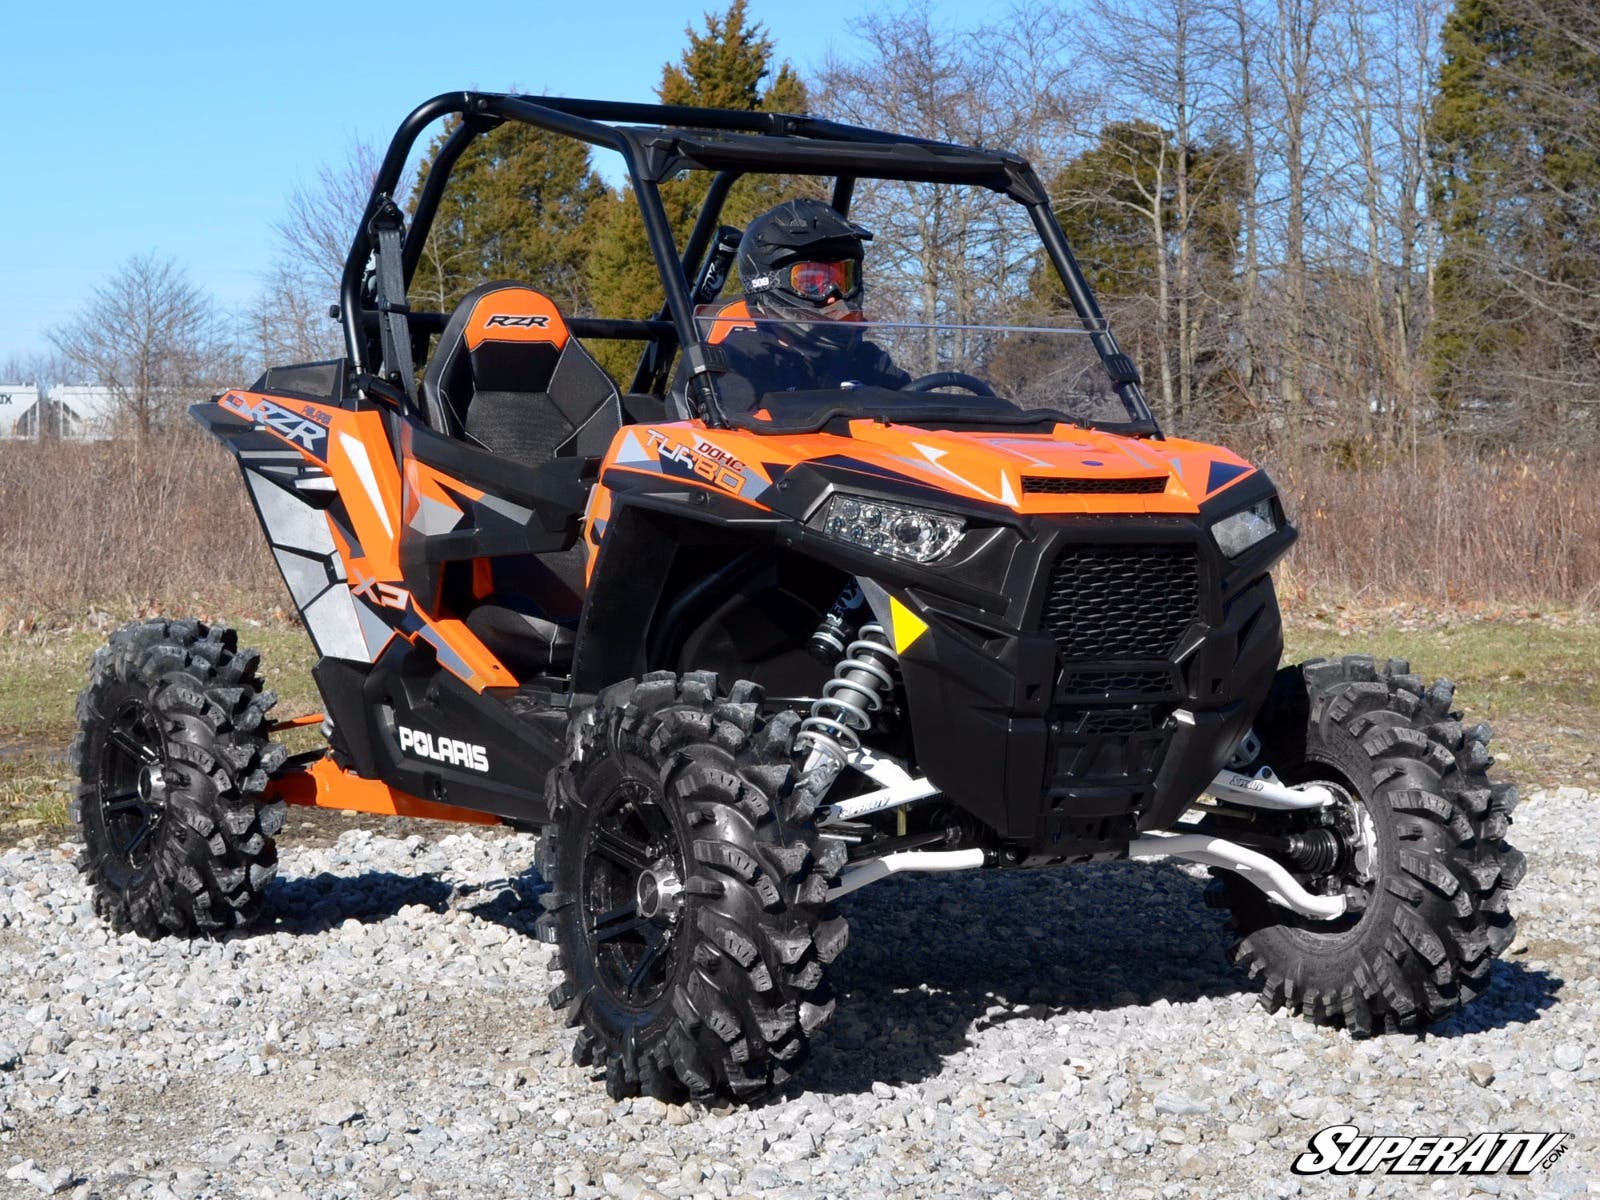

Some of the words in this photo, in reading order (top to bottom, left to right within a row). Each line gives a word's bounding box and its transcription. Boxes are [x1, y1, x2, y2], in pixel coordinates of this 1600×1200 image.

[485, 314, 550, 328] RZR
[251, 399, 327, 451] RZR
[646, 428, 747, 496] TURBO
[698, 441, 747, 474] DOHC
[399, 725, 490, 773] POLARIS
